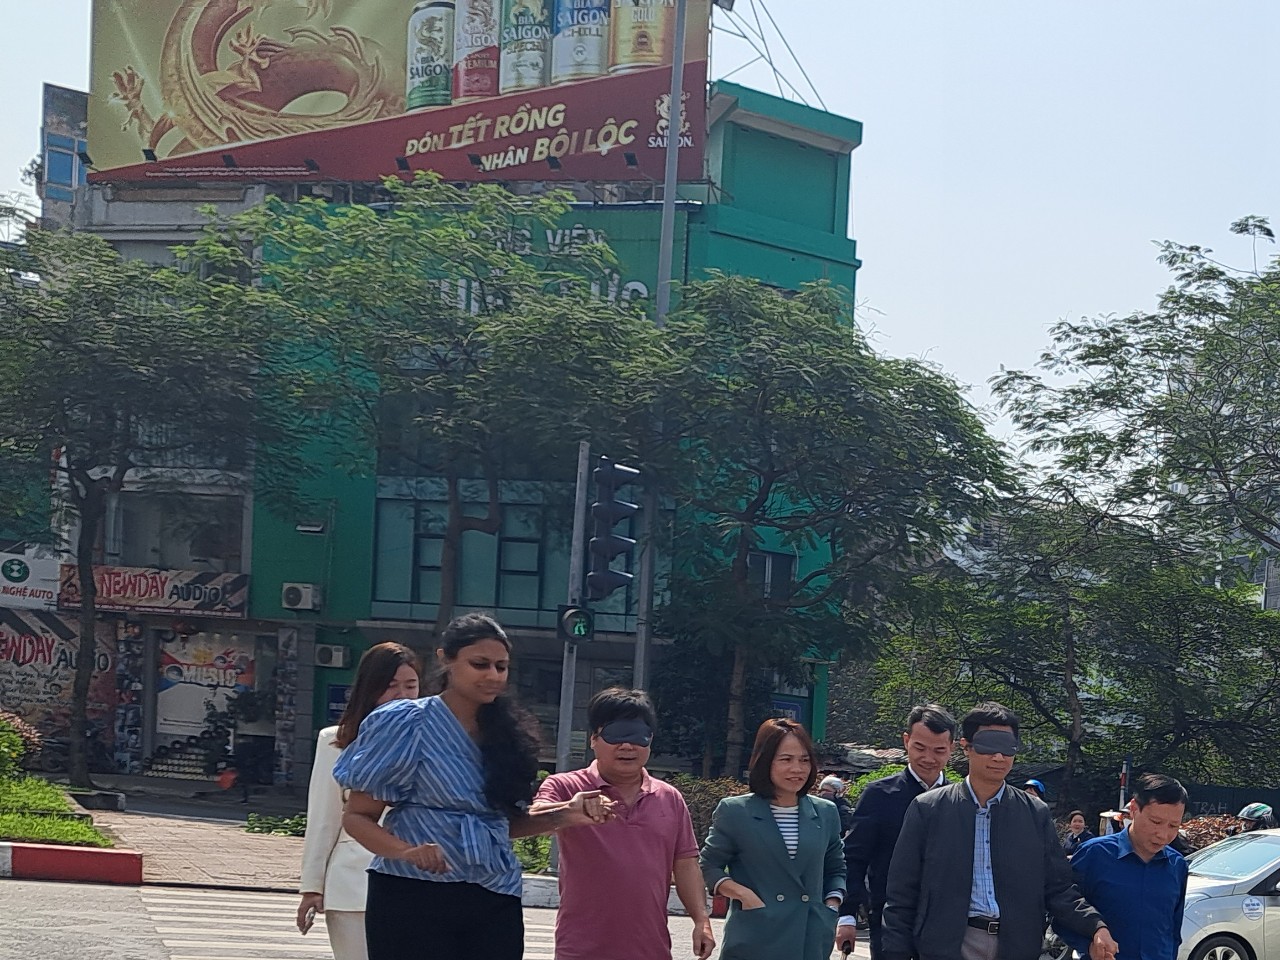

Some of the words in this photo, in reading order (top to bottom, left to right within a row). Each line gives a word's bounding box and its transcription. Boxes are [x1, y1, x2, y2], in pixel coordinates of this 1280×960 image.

[557, 9, 609, 27] SAIGON
[503, 25, 551, 41] SAIGON
[409, 63, 453, 80] SAIGON
[405, 130, 444, 157] ĐÓN
[449, 112, 493, 146] TẾT
[493, 103, 567, 138] RỒNG
[582, 117, 639, 156] LỘC
[648, 136, 692, 148] SAION
[28, 587, 54, 600] AUTO
[101, 571, 170, 599] NEWDAY
